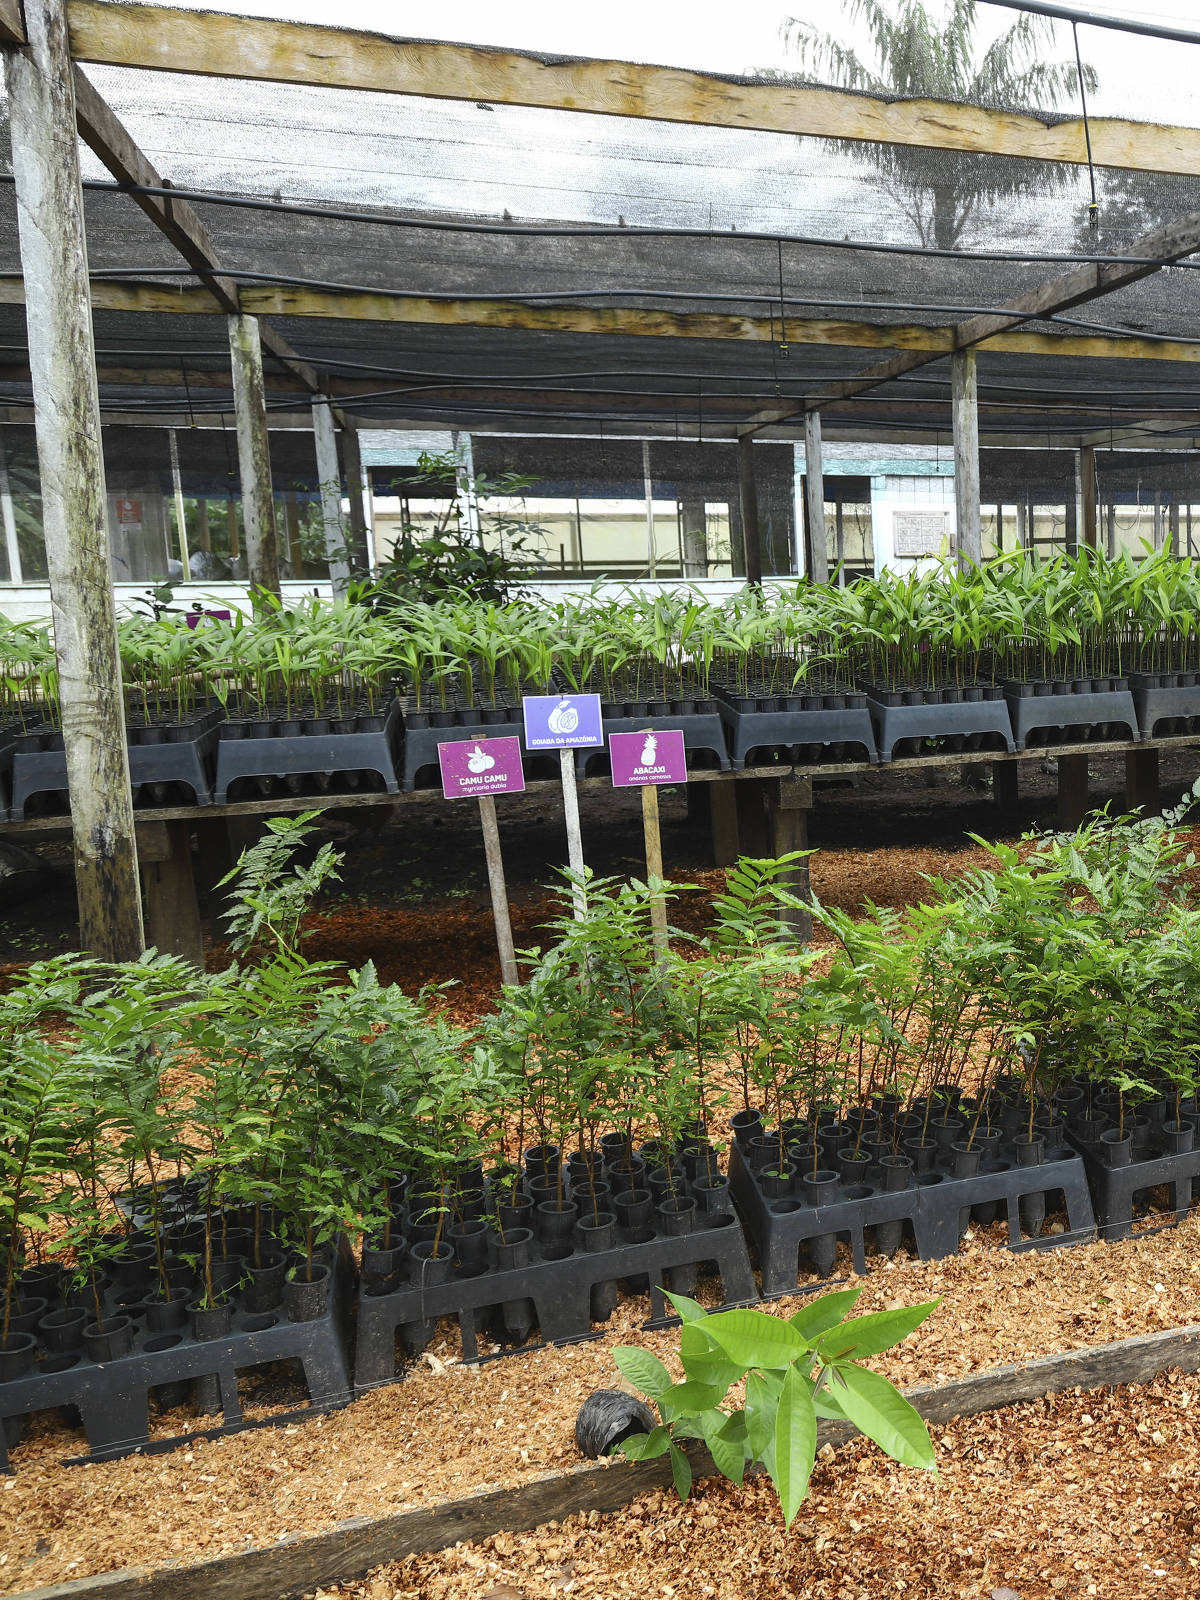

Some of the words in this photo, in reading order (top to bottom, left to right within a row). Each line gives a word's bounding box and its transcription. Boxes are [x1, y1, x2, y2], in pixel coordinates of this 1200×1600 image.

[633, 766, 666, 775] ABACAXI
[459, 776, 483, 786] CAMU
[484, 773, 508, 783] CAMU
